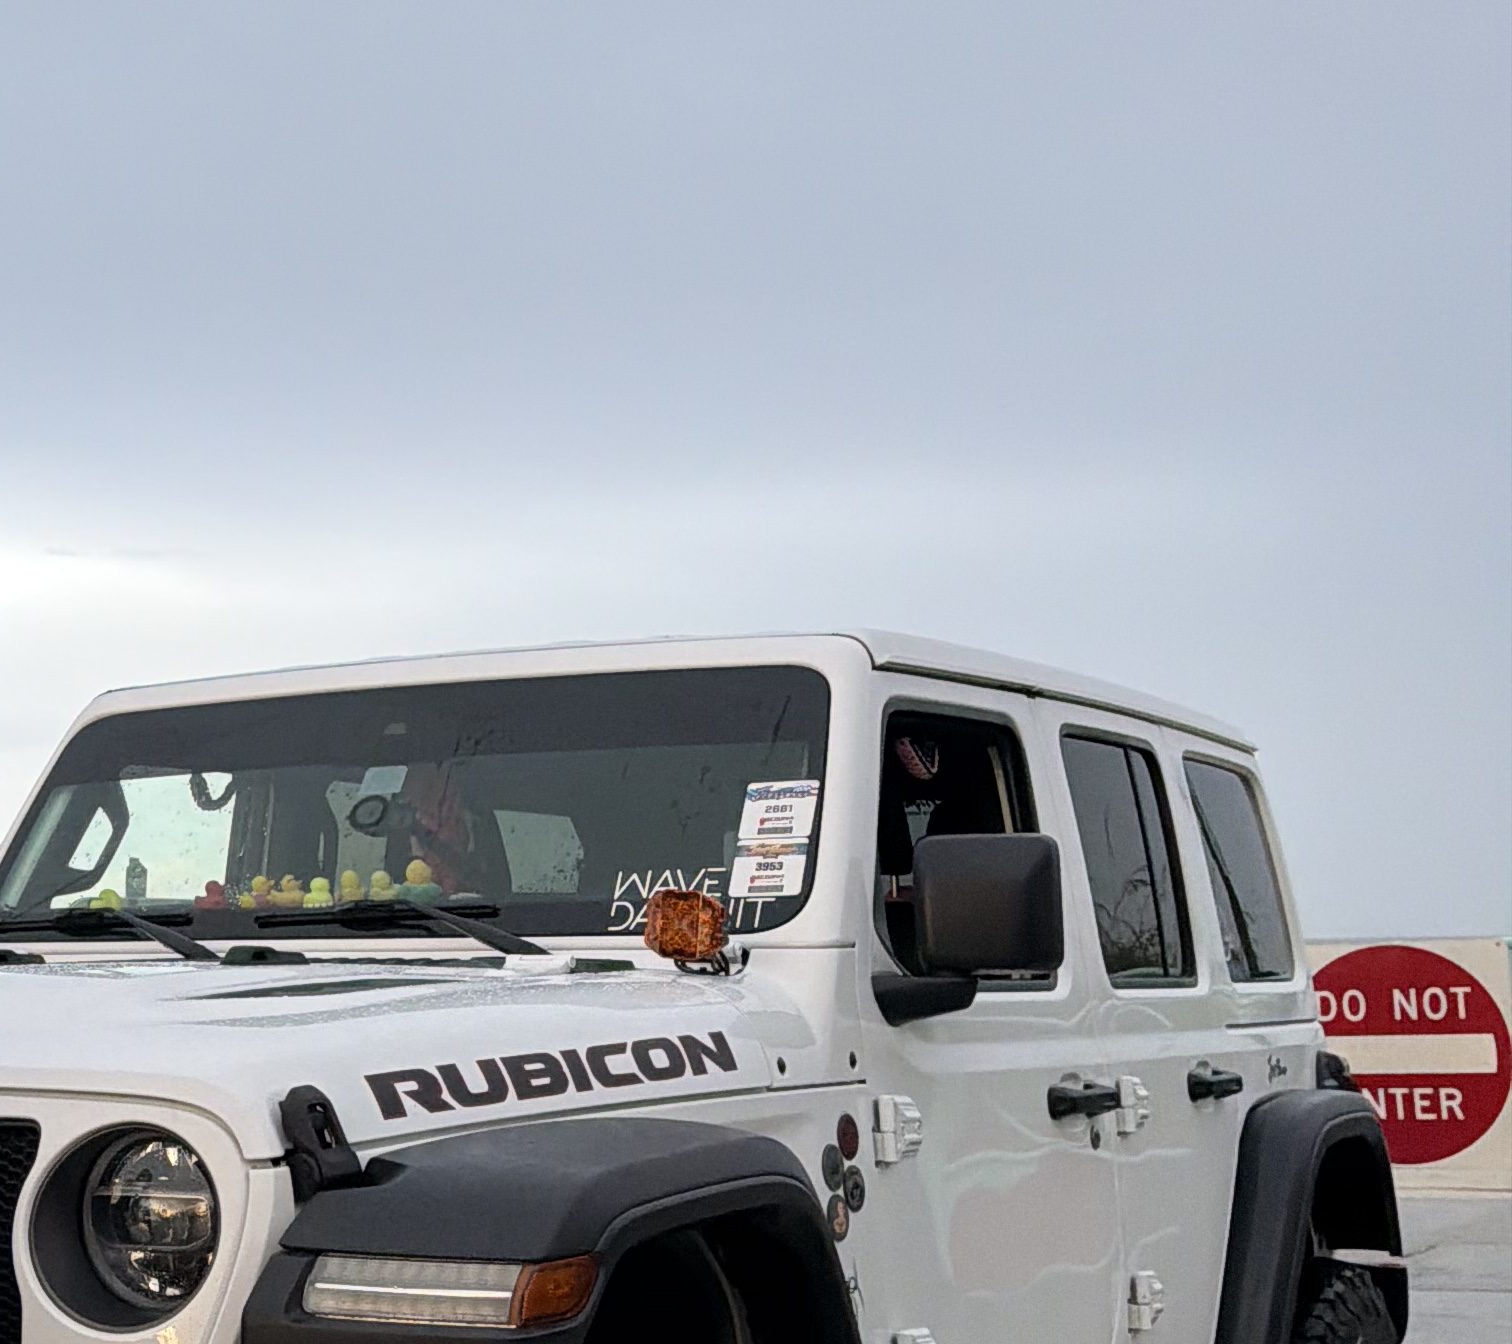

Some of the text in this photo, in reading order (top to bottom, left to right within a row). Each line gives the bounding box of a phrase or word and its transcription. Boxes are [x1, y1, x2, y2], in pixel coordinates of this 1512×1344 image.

[755, 861, 784, 871] 3953
[613, 867, 727, 900] WAVE
[1315, 986, 1472, 1023] DO NOT
[364, 1031, 739, 1121] RUBICON
[1361, 1087, 1466, 1121] NTER
